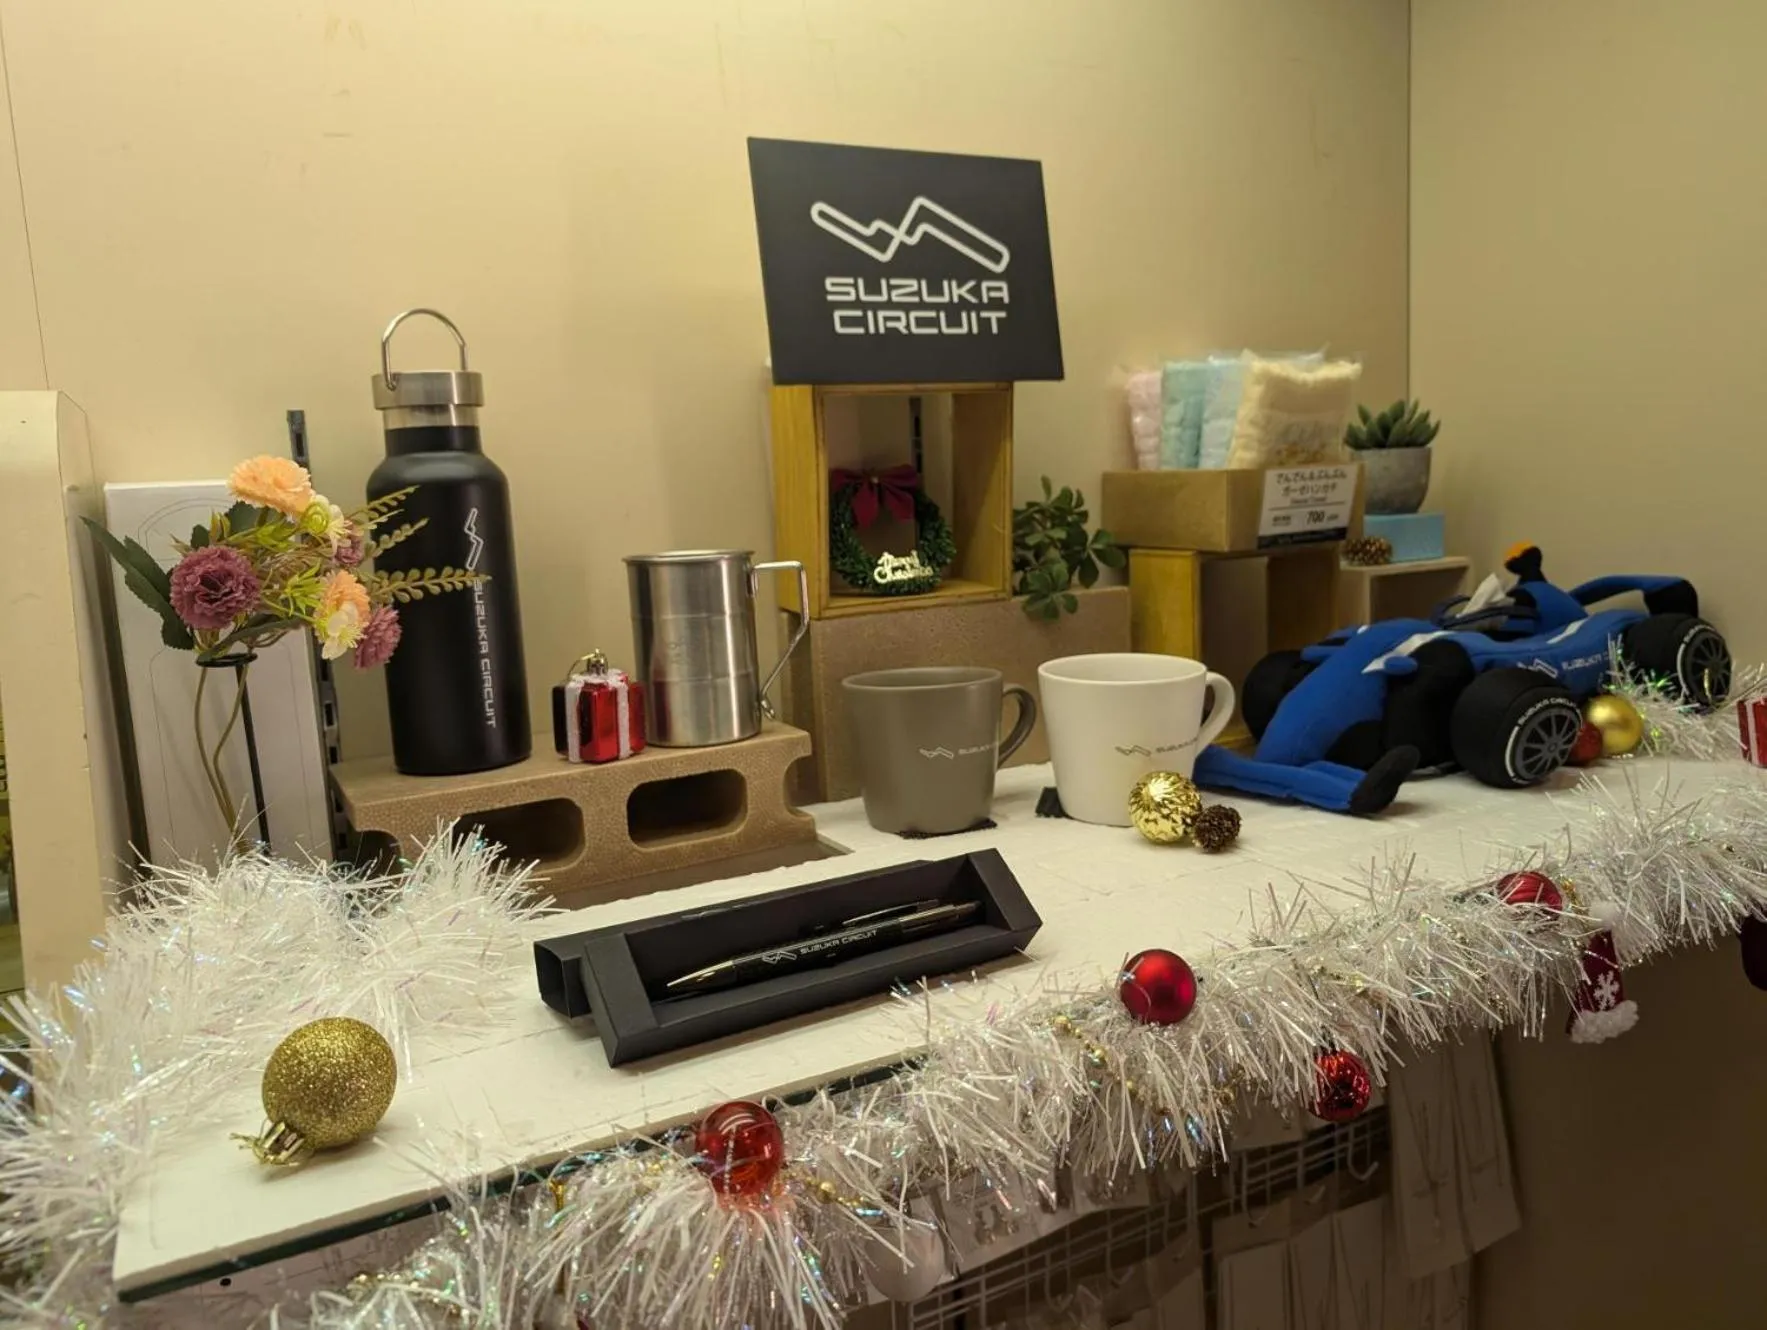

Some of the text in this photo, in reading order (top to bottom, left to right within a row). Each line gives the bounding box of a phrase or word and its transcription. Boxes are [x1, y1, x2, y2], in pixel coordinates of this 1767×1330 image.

[825, 276, 1010, 304] SUZUKA
[833, 309, 1007, 335] CIRCUIT
[1306, 510, 1326, 525] 700
[474, 579, 497, 729] SUZUKA CIRCUIT
[800, 929, 877, 955] SUZUKA CIRCUIT
